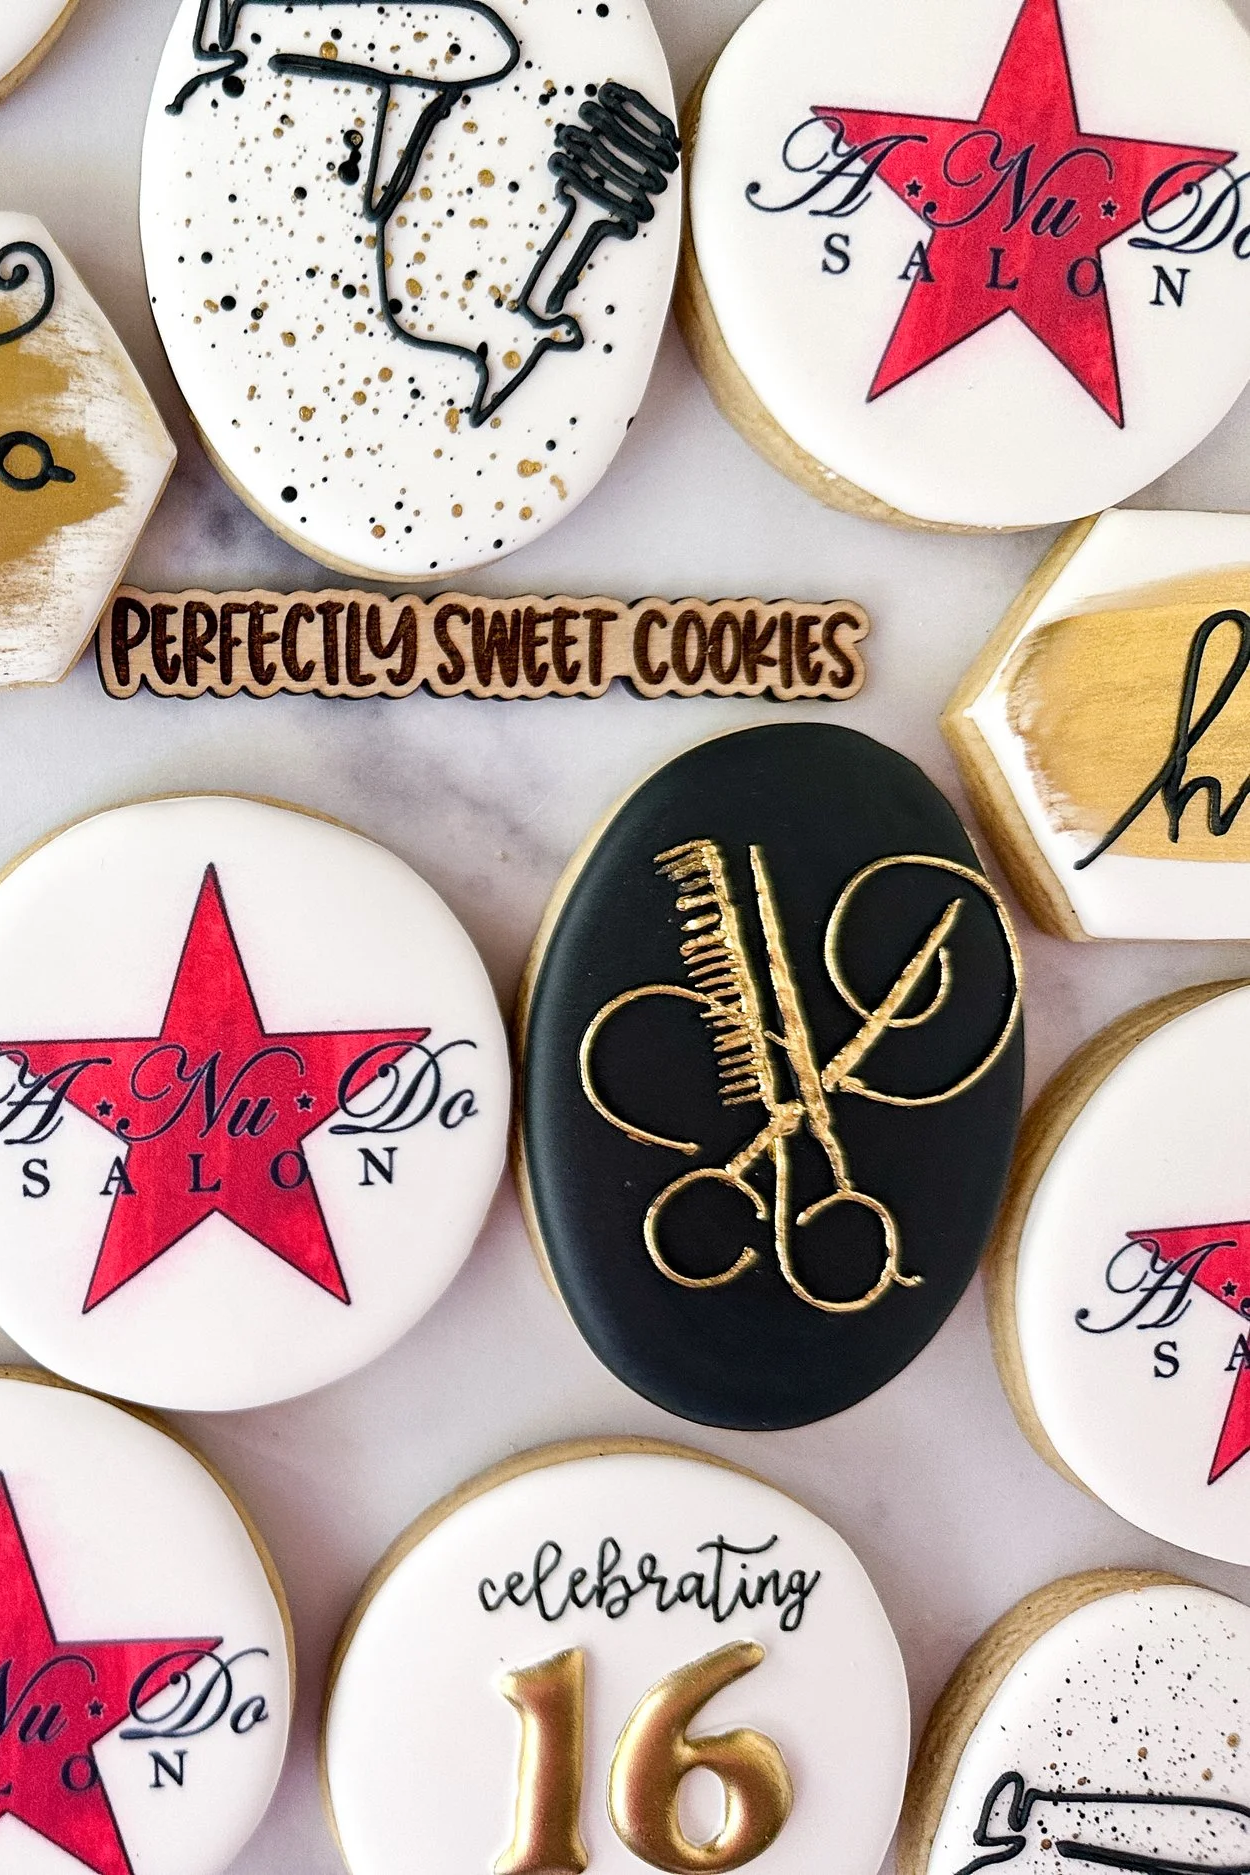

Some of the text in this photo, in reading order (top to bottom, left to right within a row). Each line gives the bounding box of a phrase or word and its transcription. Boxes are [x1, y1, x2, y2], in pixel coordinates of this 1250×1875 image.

[922, 129, 1114, 237] Nu
[820, 233, 1190, 307] SALON
[111, 596, 859, 690] PERFECTLY SWEET COOKIES
[114, 1043, 306, 1142] Nu
[328, 1039, 478, 1136] Do
[22, 1145, 398, 1198] SALON
[477, 1533, 823, 1633] celebrating
[118, 1646, 271, 1741] Do
[494, 1638, 795, 1875] 16
